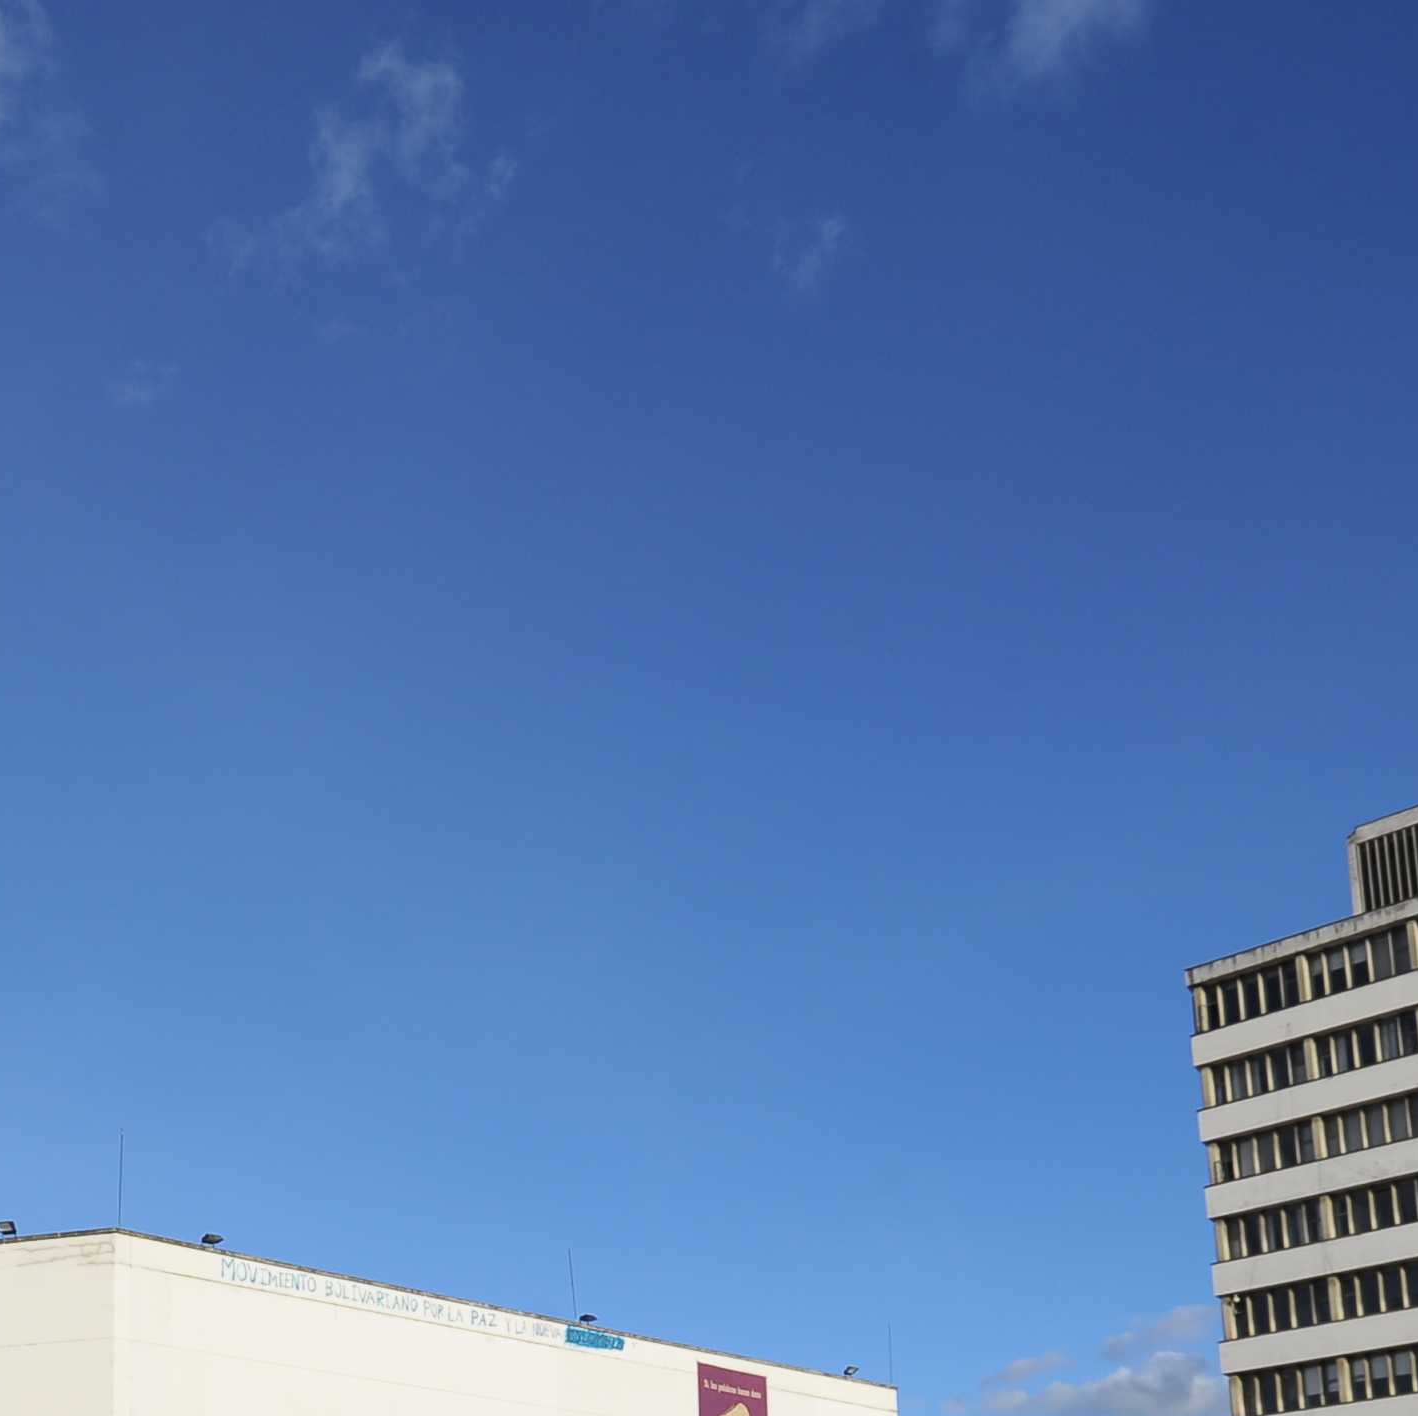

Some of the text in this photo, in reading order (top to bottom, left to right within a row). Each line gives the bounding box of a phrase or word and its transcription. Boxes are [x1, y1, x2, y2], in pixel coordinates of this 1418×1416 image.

[221, 1257, 317, 1292] MOVIMIENTO
[325, 1280, 418, 1312] BOLIVARIANO
[423, 1300, 445, 1319] POR
[448, 1306, 464, 1323] LA
[471, 1310, 498, 1328] PAZ
[505, 1317, 512, 1334] Y
[515, 1320, 529, 1335] LA
